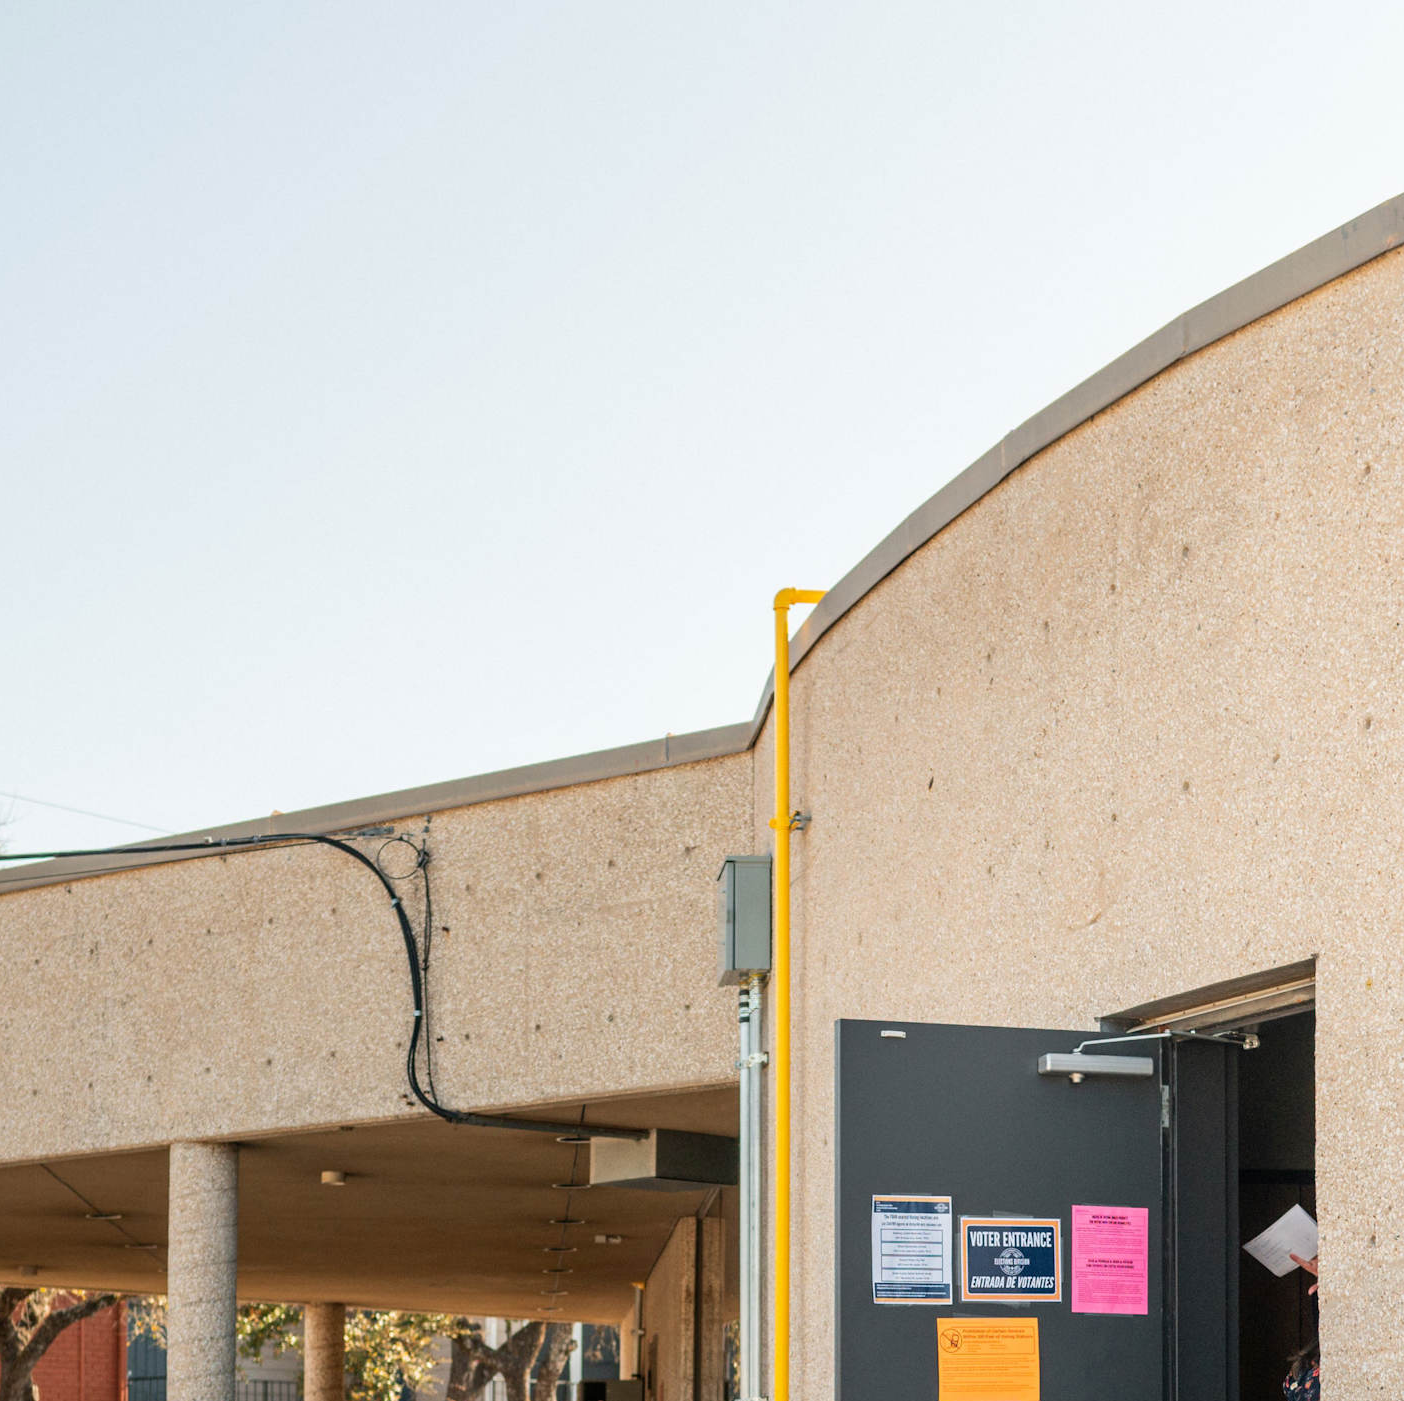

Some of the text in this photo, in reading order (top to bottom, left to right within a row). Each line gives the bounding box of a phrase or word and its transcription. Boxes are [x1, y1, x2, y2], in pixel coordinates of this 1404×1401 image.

[969, 1231, 1053, 1248] VOTER ENTRANCE
[970, 1275, 1055, 1289] ENTRADA DE VOTANTES
